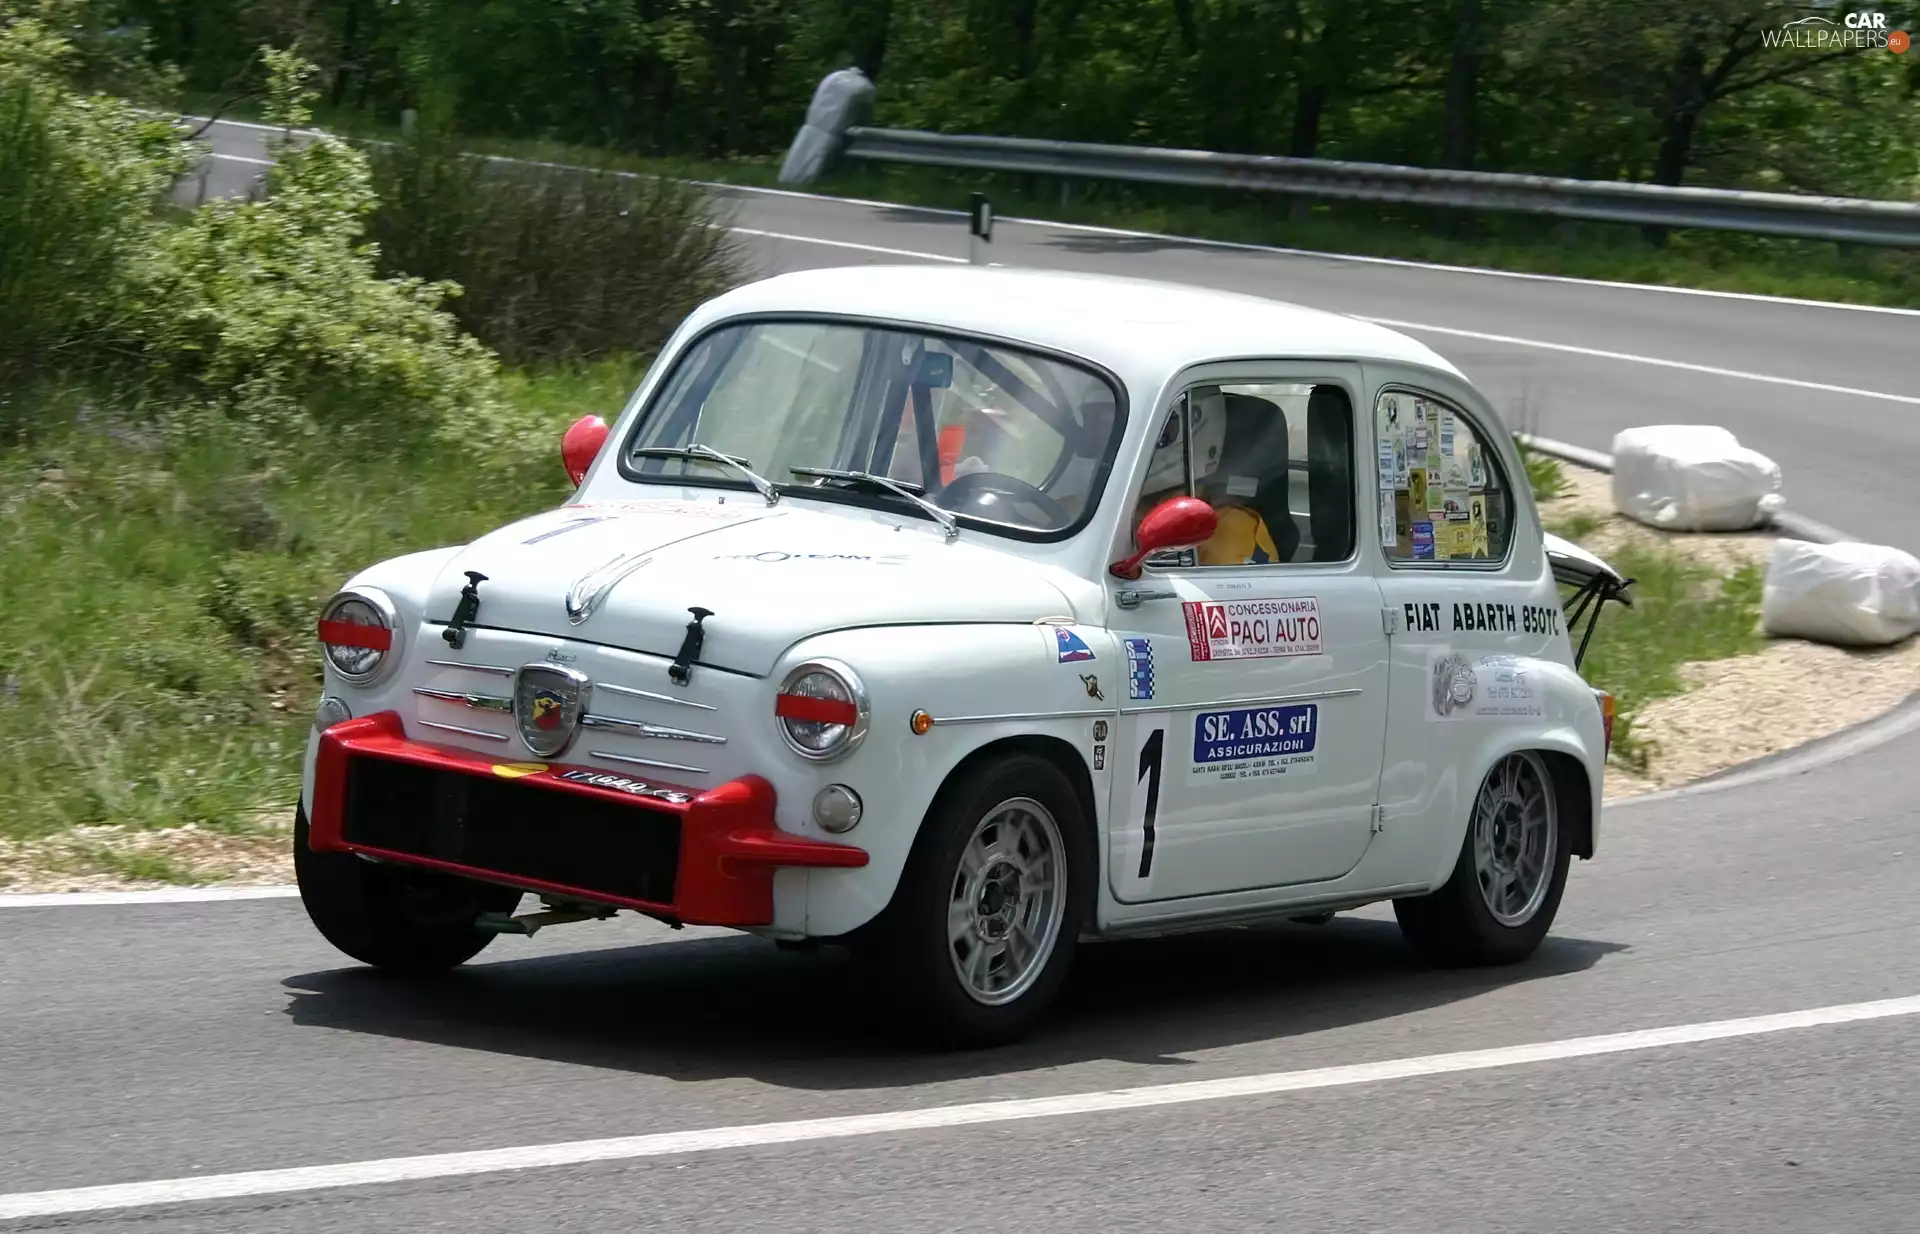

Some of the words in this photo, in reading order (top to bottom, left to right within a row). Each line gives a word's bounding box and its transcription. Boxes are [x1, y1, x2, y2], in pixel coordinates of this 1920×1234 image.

[1228, 600, 1317, 617] CONCESSIONARIA
[1404, 603, 1441, 632] FIAT
[1453, 603, 1516, 632] ABARTH
[1523, 605, 1559, 636] 850TC
[1230, 619, 1270, 646] PACI
[1275, 616, 1320, 643] AUTO
[1203, 714, 1235, 742] SE.
[1240, 710, 1285, 739] ASS.
[1289, 707, 1312, 735] srl
[1207, 739, 1304, 759] ASSICURAZIONI
[1138, 729, 1164, 878] 1
